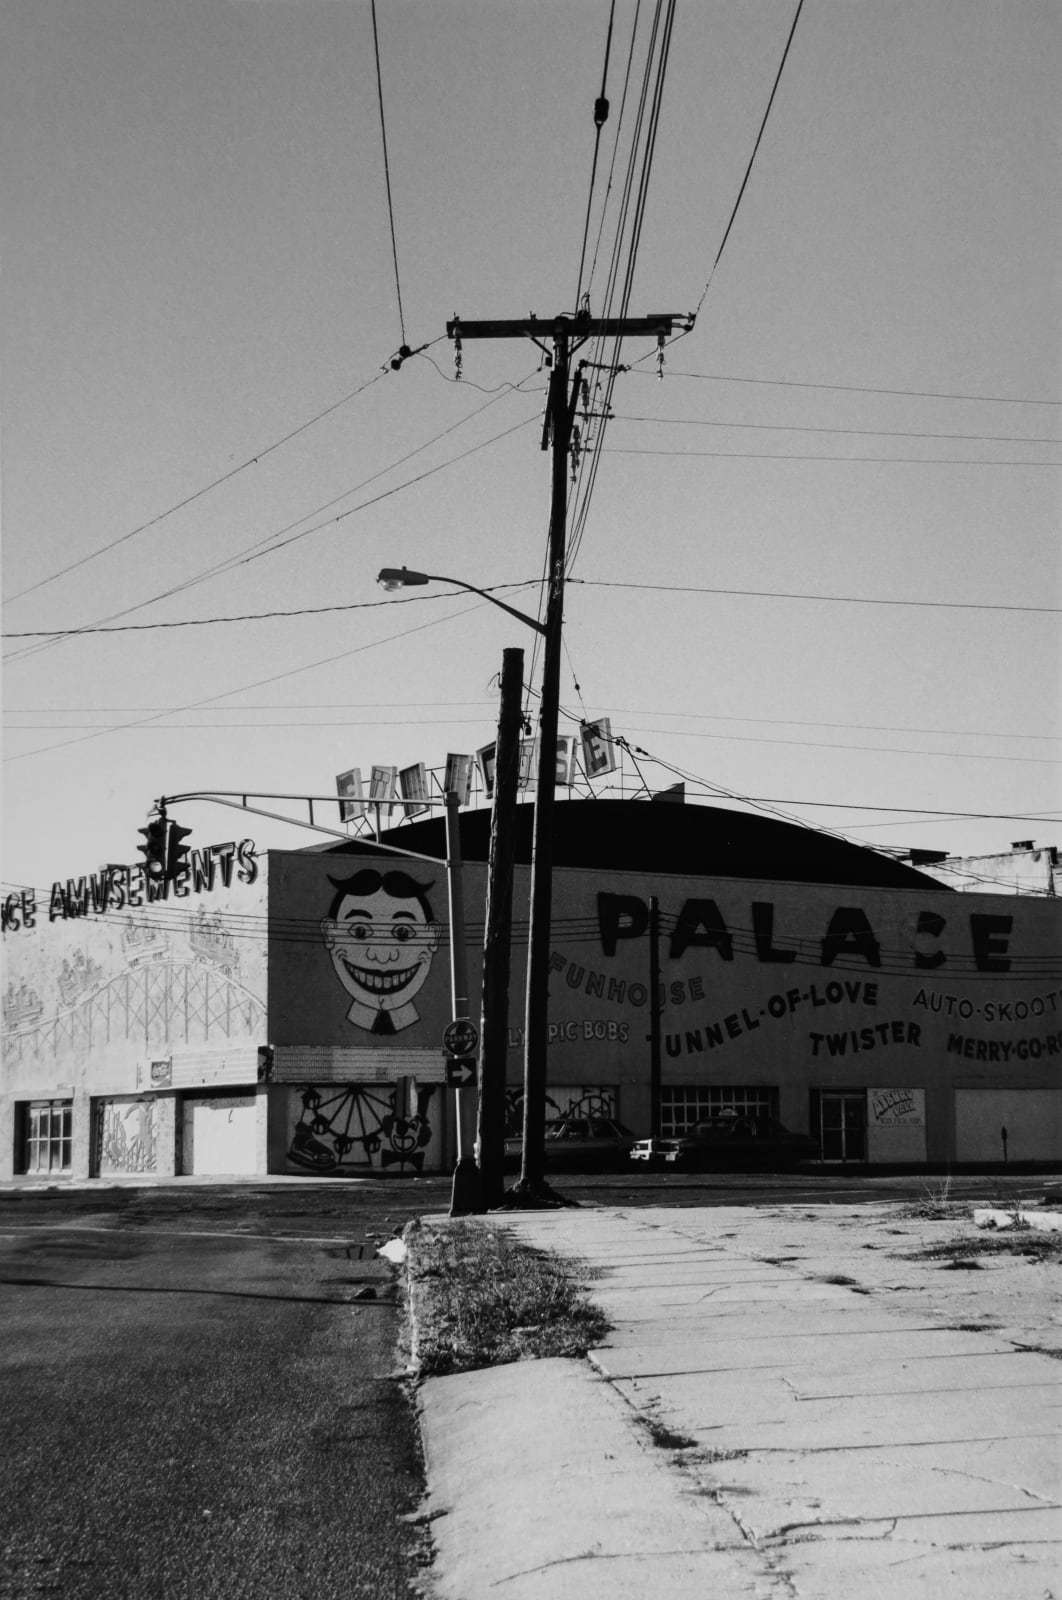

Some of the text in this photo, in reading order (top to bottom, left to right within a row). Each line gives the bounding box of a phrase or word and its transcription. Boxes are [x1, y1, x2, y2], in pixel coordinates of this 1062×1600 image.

[1, 838, 258, 933] CE AMUSEMENTS
[597, 890, 1013, 972] PALACE
[808, 1020, 922, 1057] TWISTER
